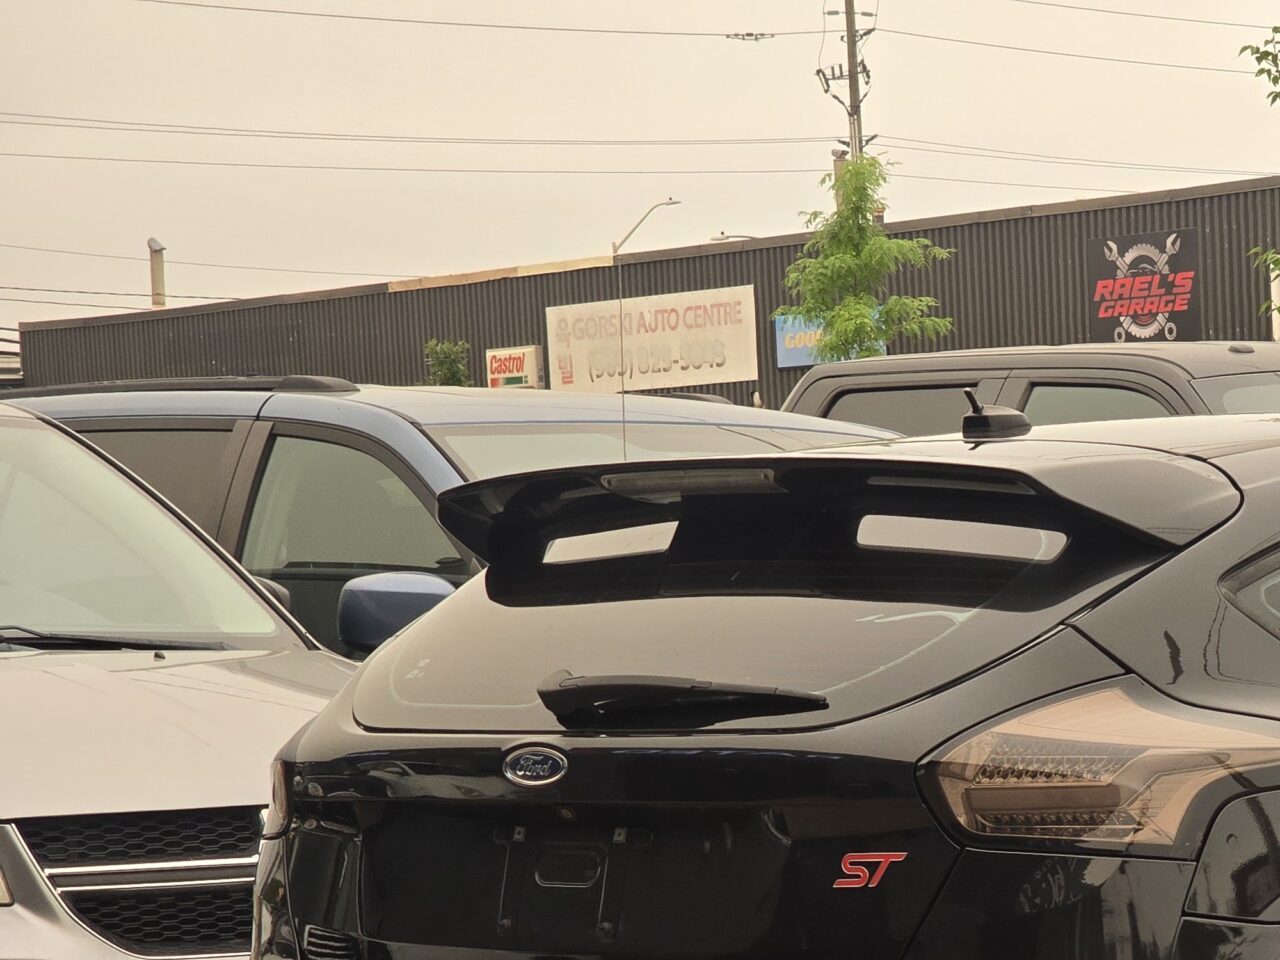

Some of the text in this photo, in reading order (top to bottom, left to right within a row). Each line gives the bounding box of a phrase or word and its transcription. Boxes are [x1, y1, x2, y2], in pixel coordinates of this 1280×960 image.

[1093, 271, 1195, 301] RAEL'S
[636, 307, 680, 334] AUTO
[683, 301, 743, 329] CENTRE
[1098, 293, 1191, 318] GARAGE
[490, 353, 525, 375] Castrol
[516, 755, 552, 776] Ford
[833, 852, 908, 888] ST
